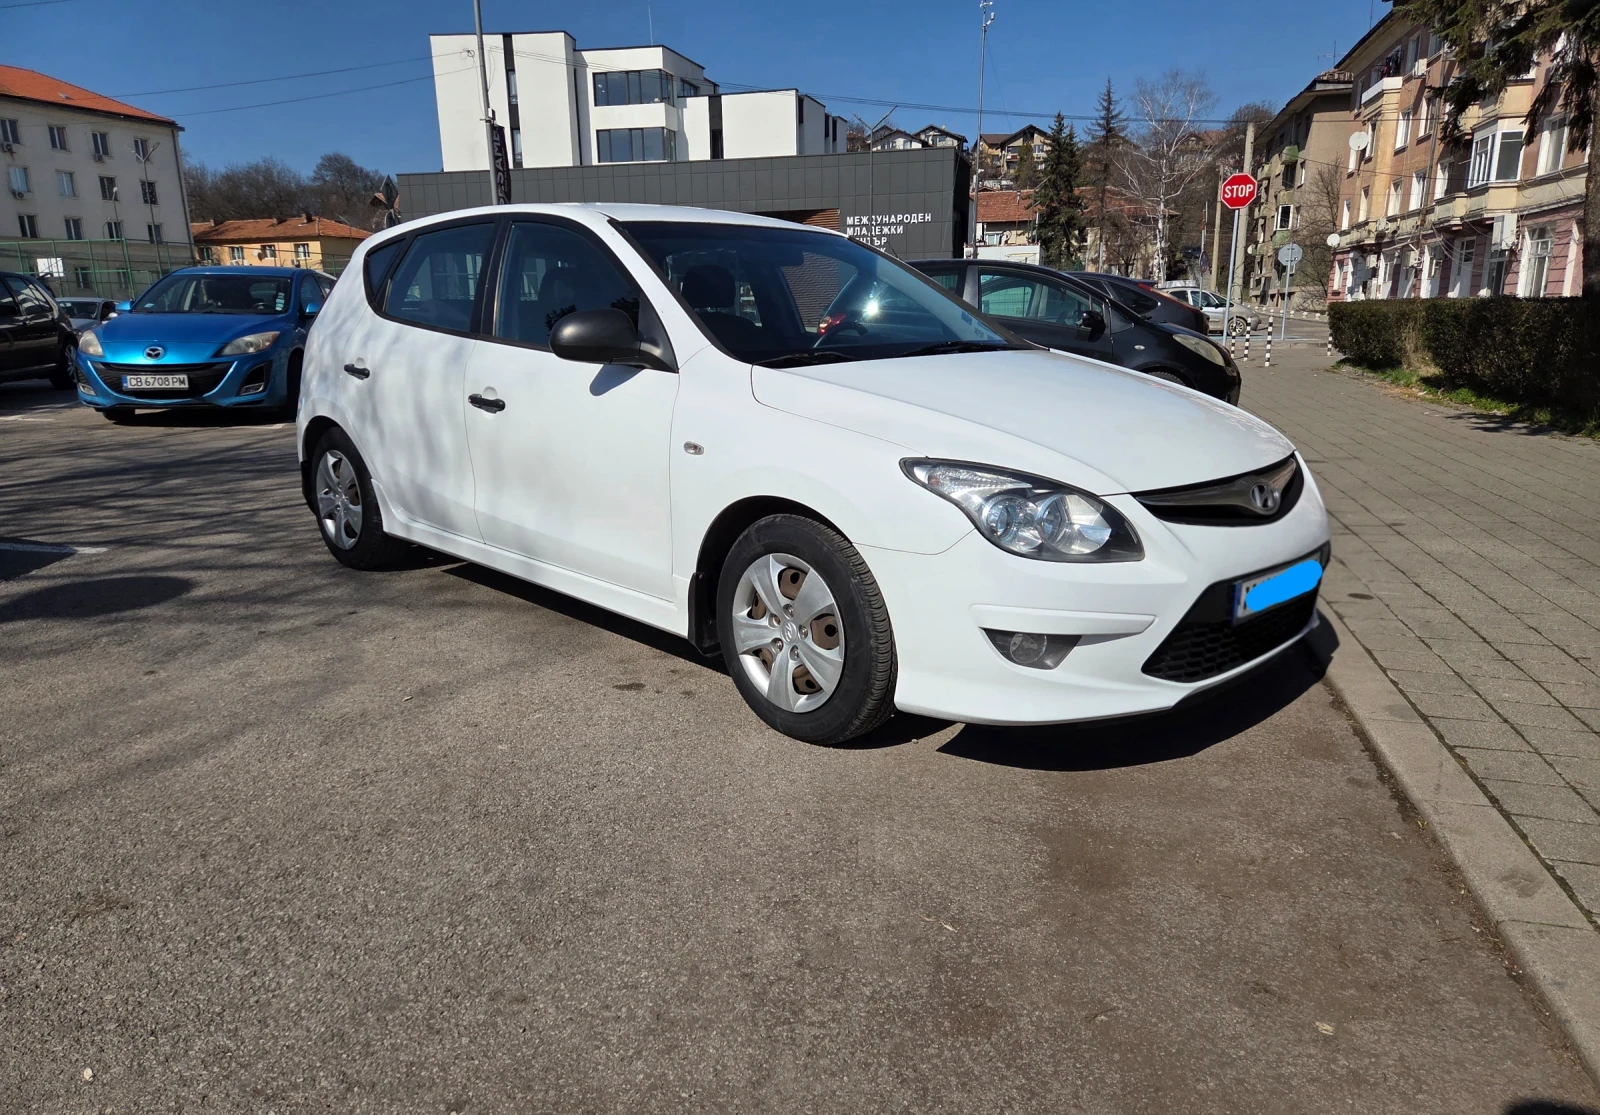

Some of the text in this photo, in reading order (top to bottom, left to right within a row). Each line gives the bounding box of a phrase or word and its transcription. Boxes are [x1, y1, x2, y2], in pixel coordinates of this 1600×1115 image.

[1224, 184, 1254, 198] STOP
[144, 376, 170, 387] 6708
[171, 376, 187, 387] PM
